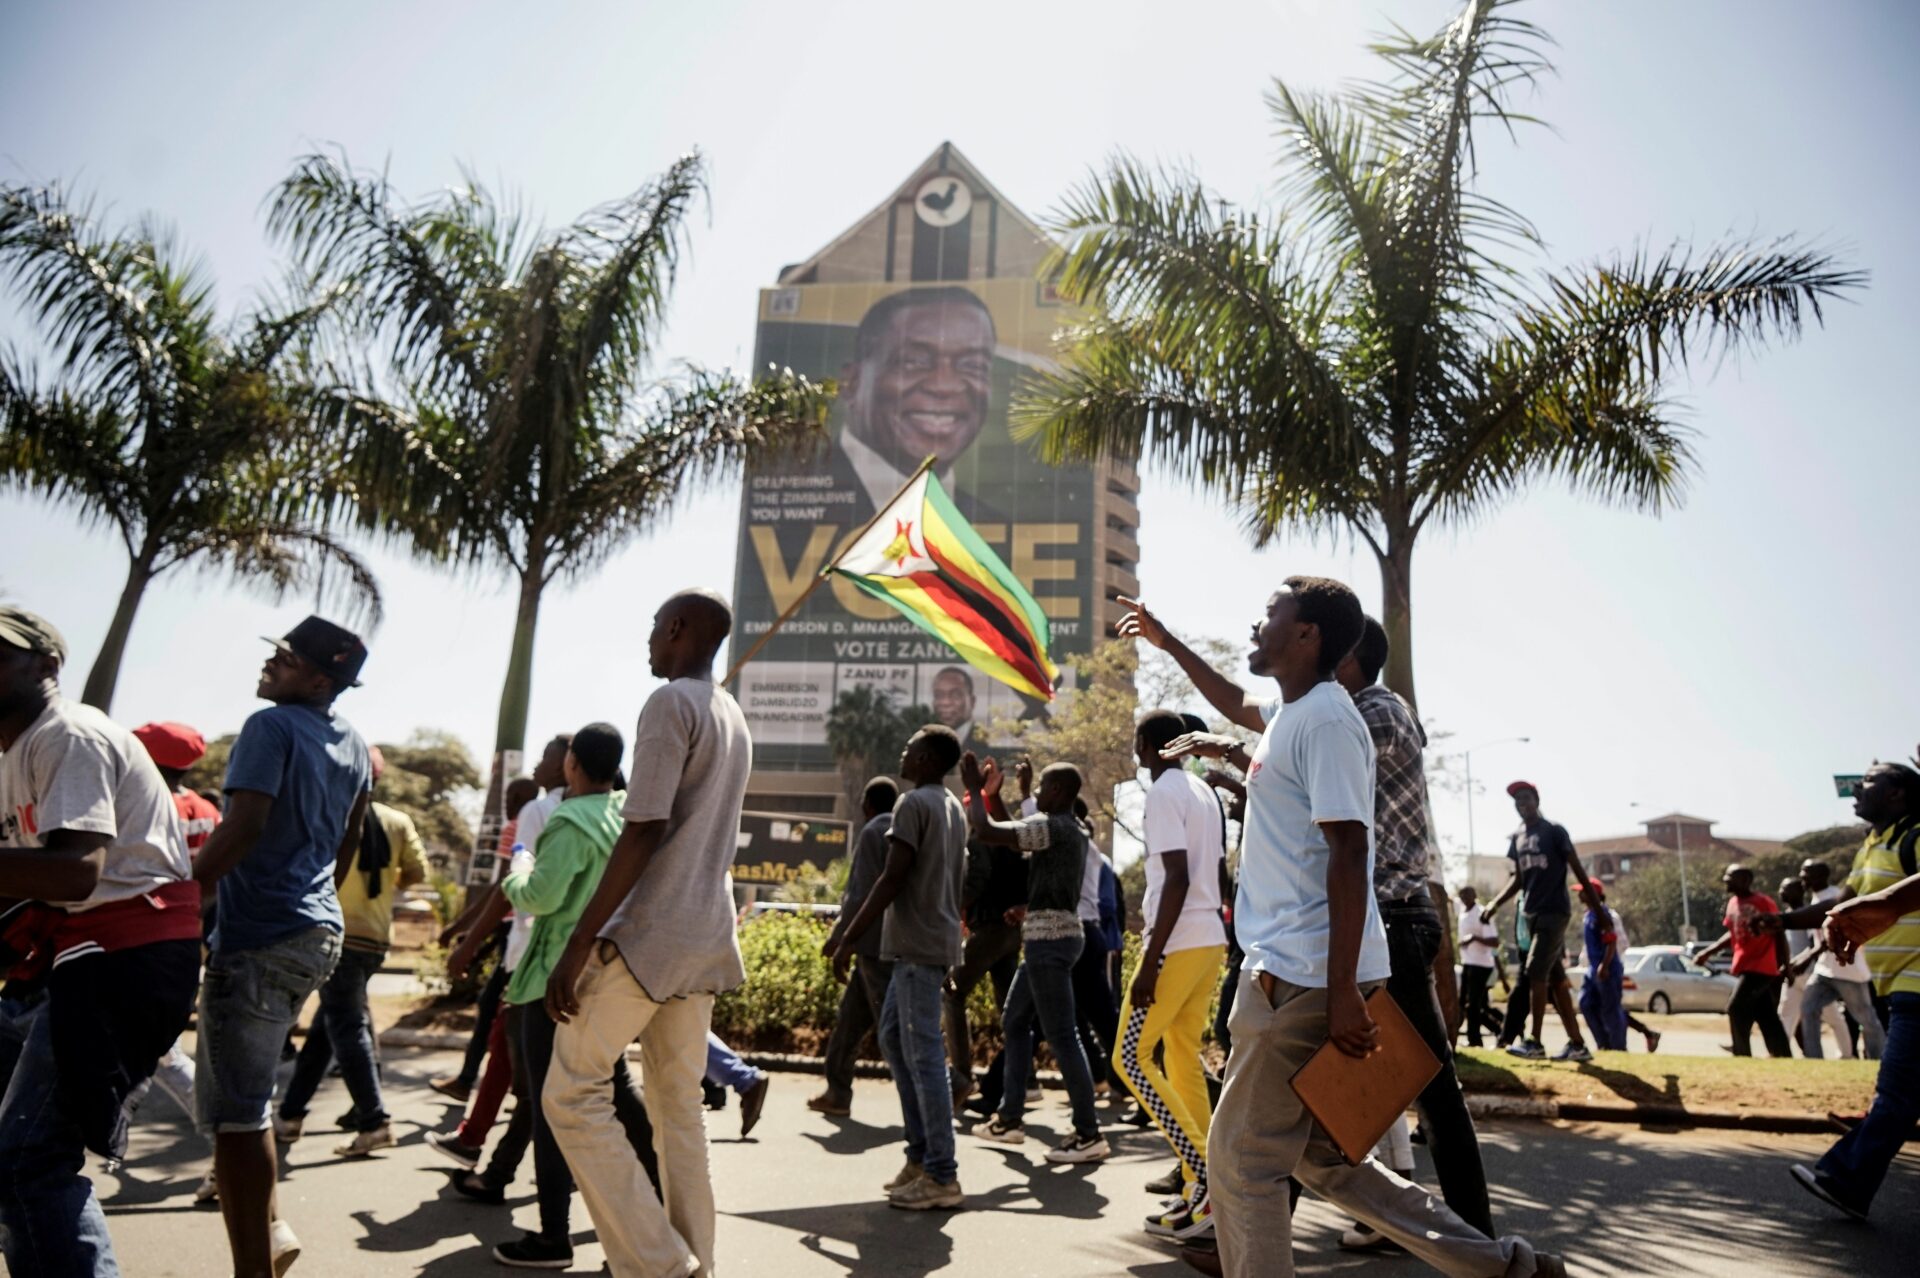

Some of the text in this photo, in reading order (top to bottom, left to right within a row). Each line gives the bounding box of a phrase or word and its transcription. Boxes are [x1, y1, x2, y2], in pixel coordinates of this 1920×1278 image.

[752, 491, 856, 504] THE ZIMBABWE
[751, 507, 826, 520] YOU WANT
[750, 524, 1080, 620] VOE
[832, 622, 848, 634] D.
[834, 641, 889, 658] VOTE
[844, 668, 910, 680] ZANU PF
[751, 682, 819, 692] EMMERSON
